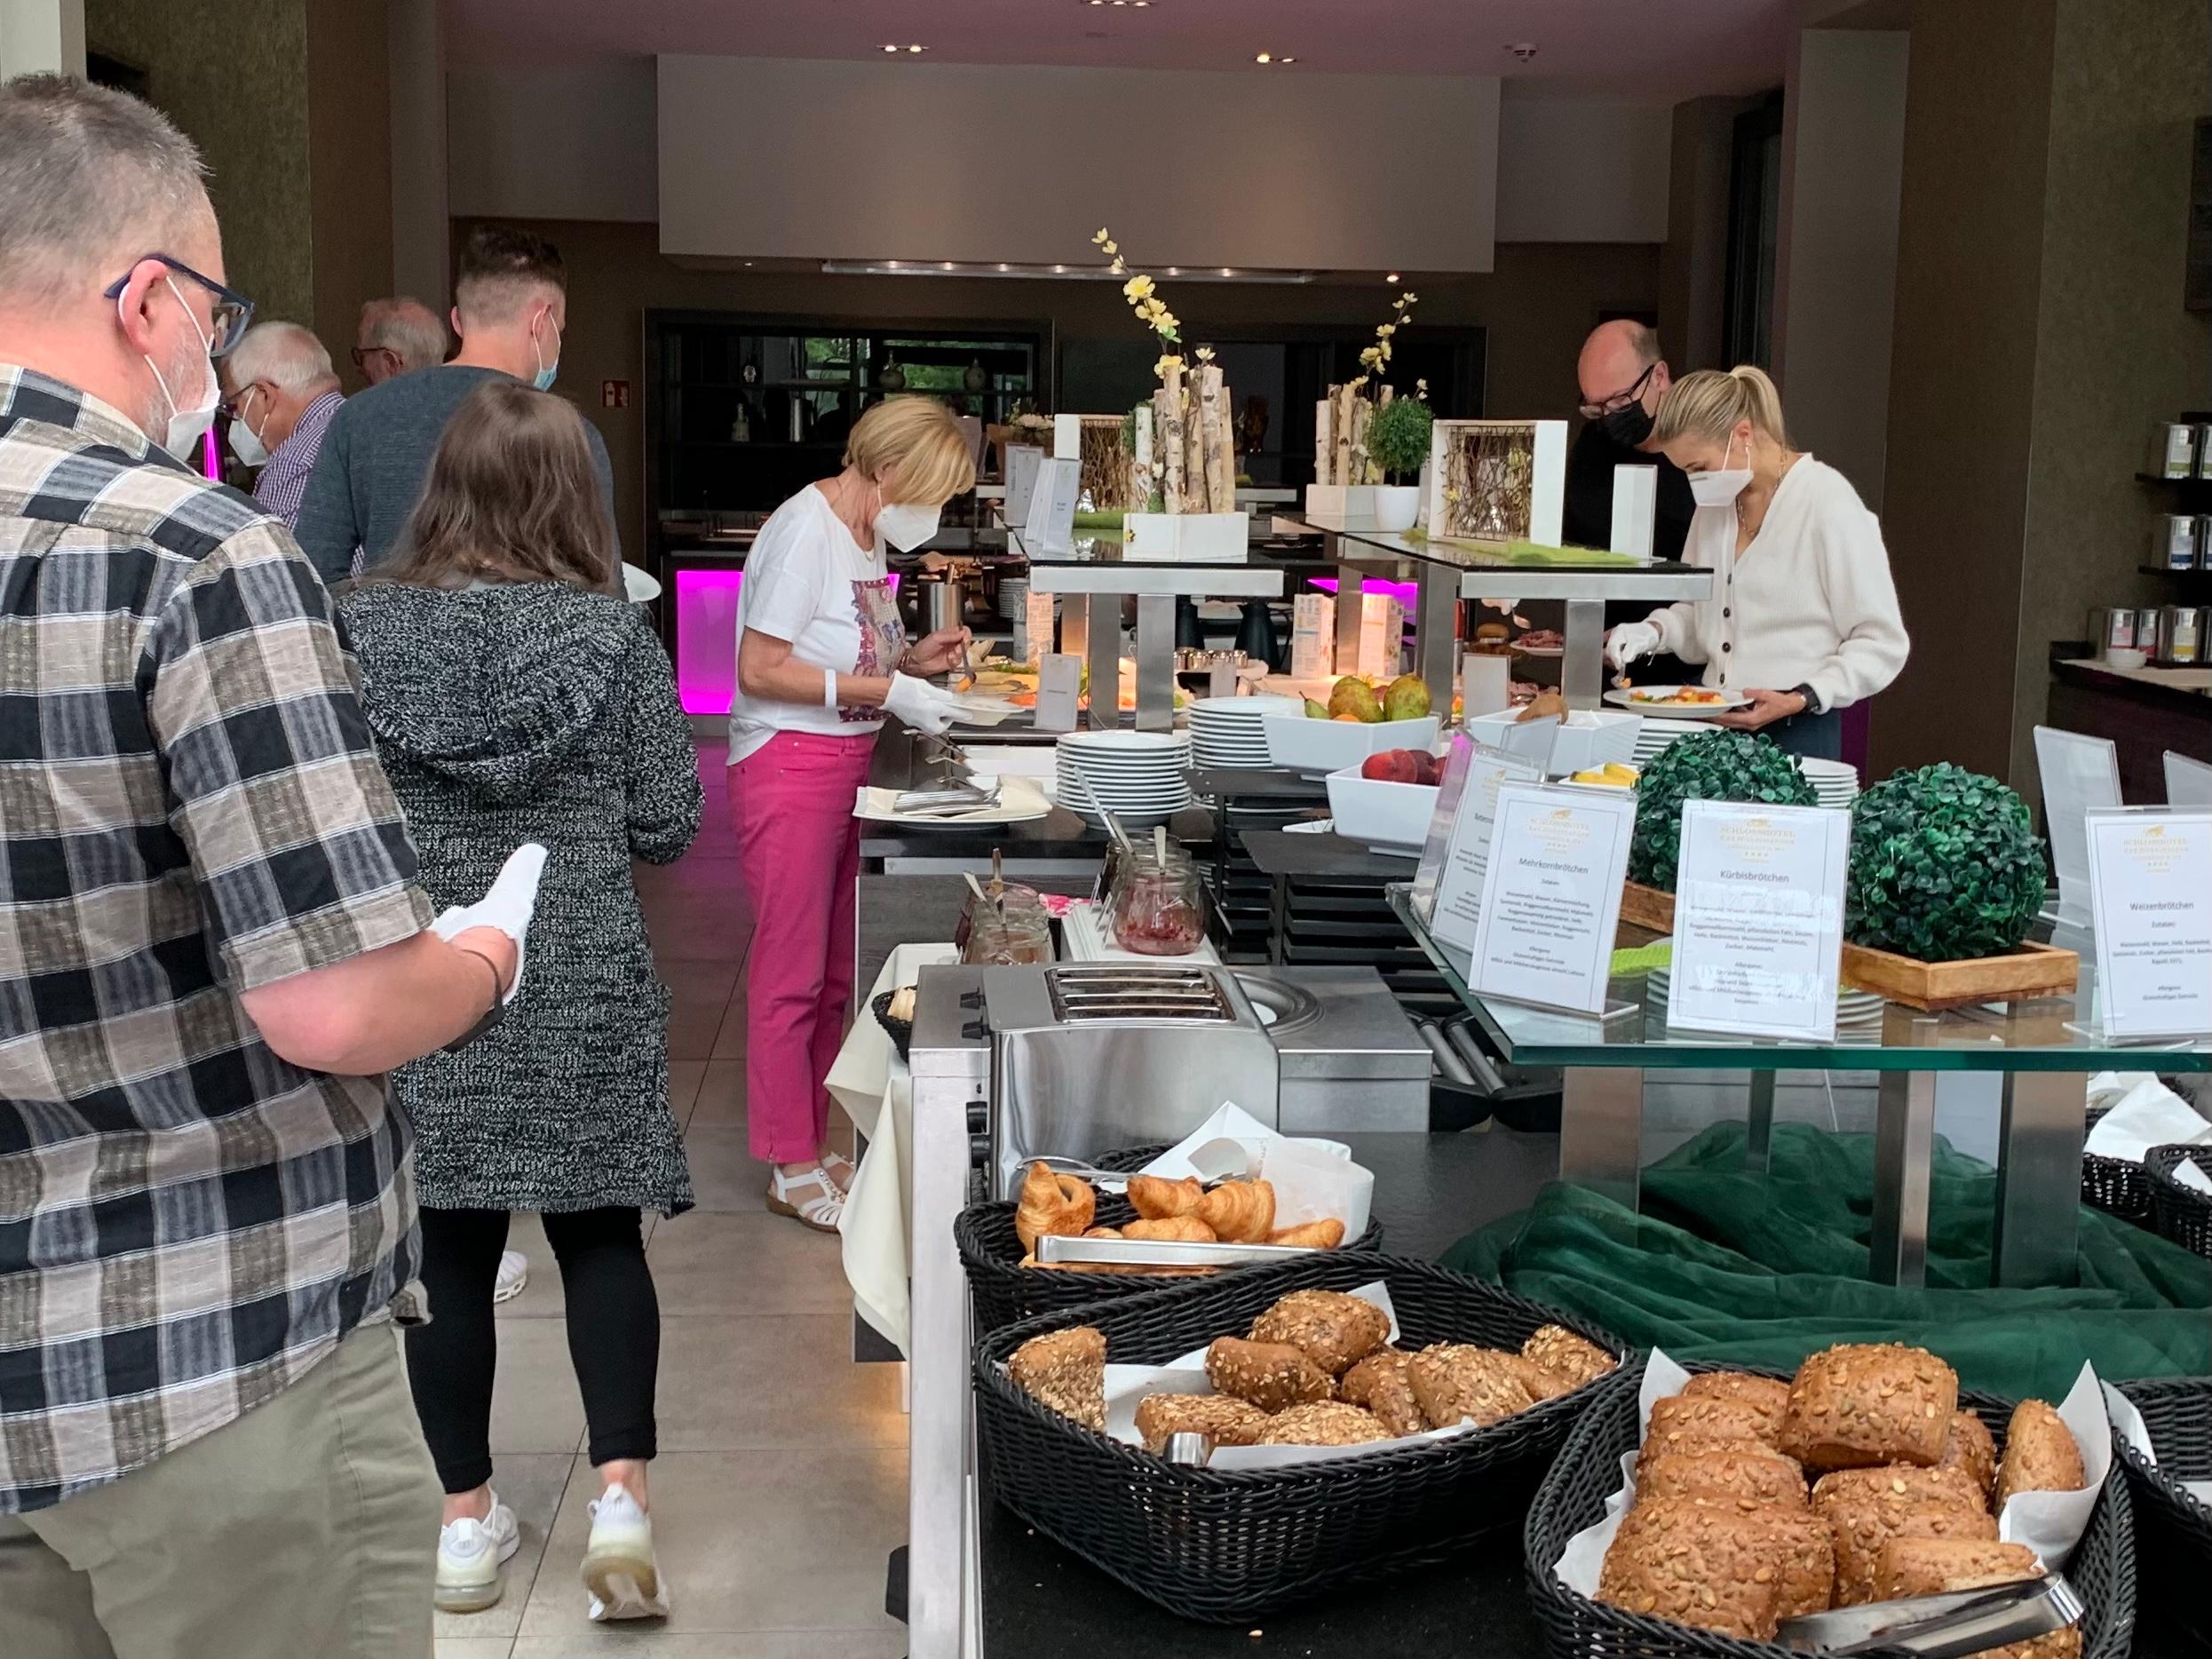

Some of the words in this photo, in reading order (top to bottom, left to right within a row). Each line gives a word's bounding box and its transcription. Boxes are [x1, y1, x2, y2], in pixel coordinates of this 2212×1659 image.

[1518, 858, 1590, 875] Mehrkornbrötchen
[1720, 869, 1789, 883] Kürbisbrötchen
[2129, 901, 2194, 911] Weizenbrötchen
